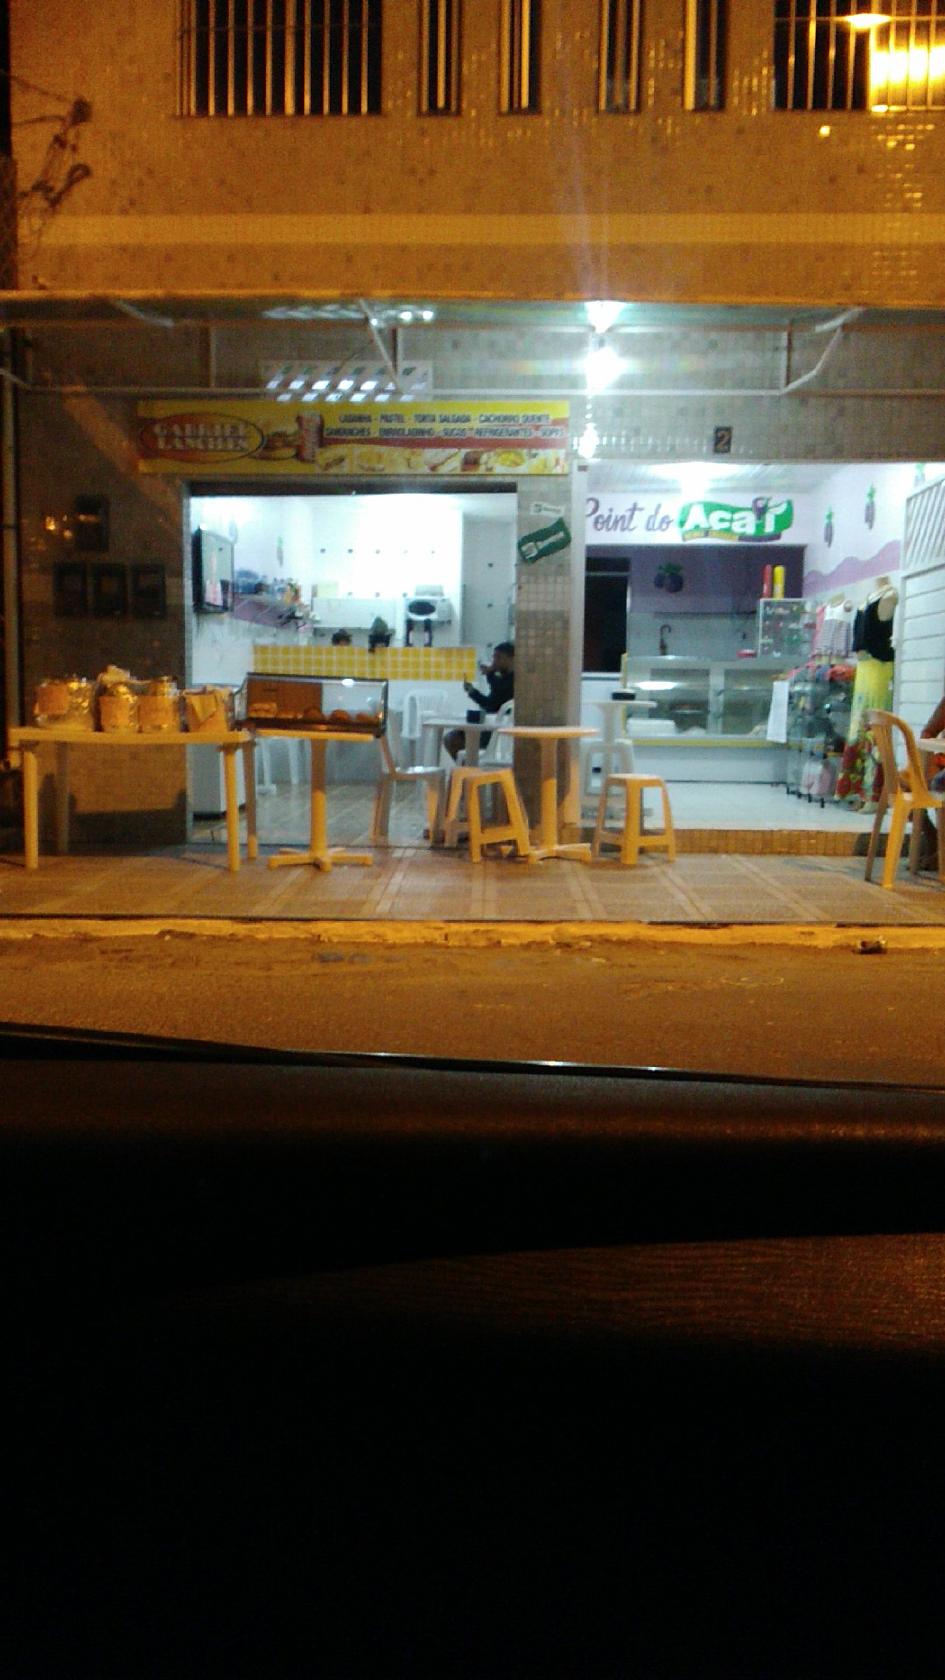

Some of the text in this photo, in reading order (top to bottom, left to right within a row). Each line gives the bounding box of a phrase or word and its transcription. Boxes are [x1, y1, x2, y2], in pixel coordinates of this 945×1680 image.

[414, 414, 435, 423] TORTA
[438, 414, 470, 423] SALGADA
[479, 414, 519, 423] CACHORRO
[520, 414, 550, 424] QUENTE
[716, 430, 730, 450] 2
[585, 498, 644, 532] Point
[645, 503, 674, 532] do
